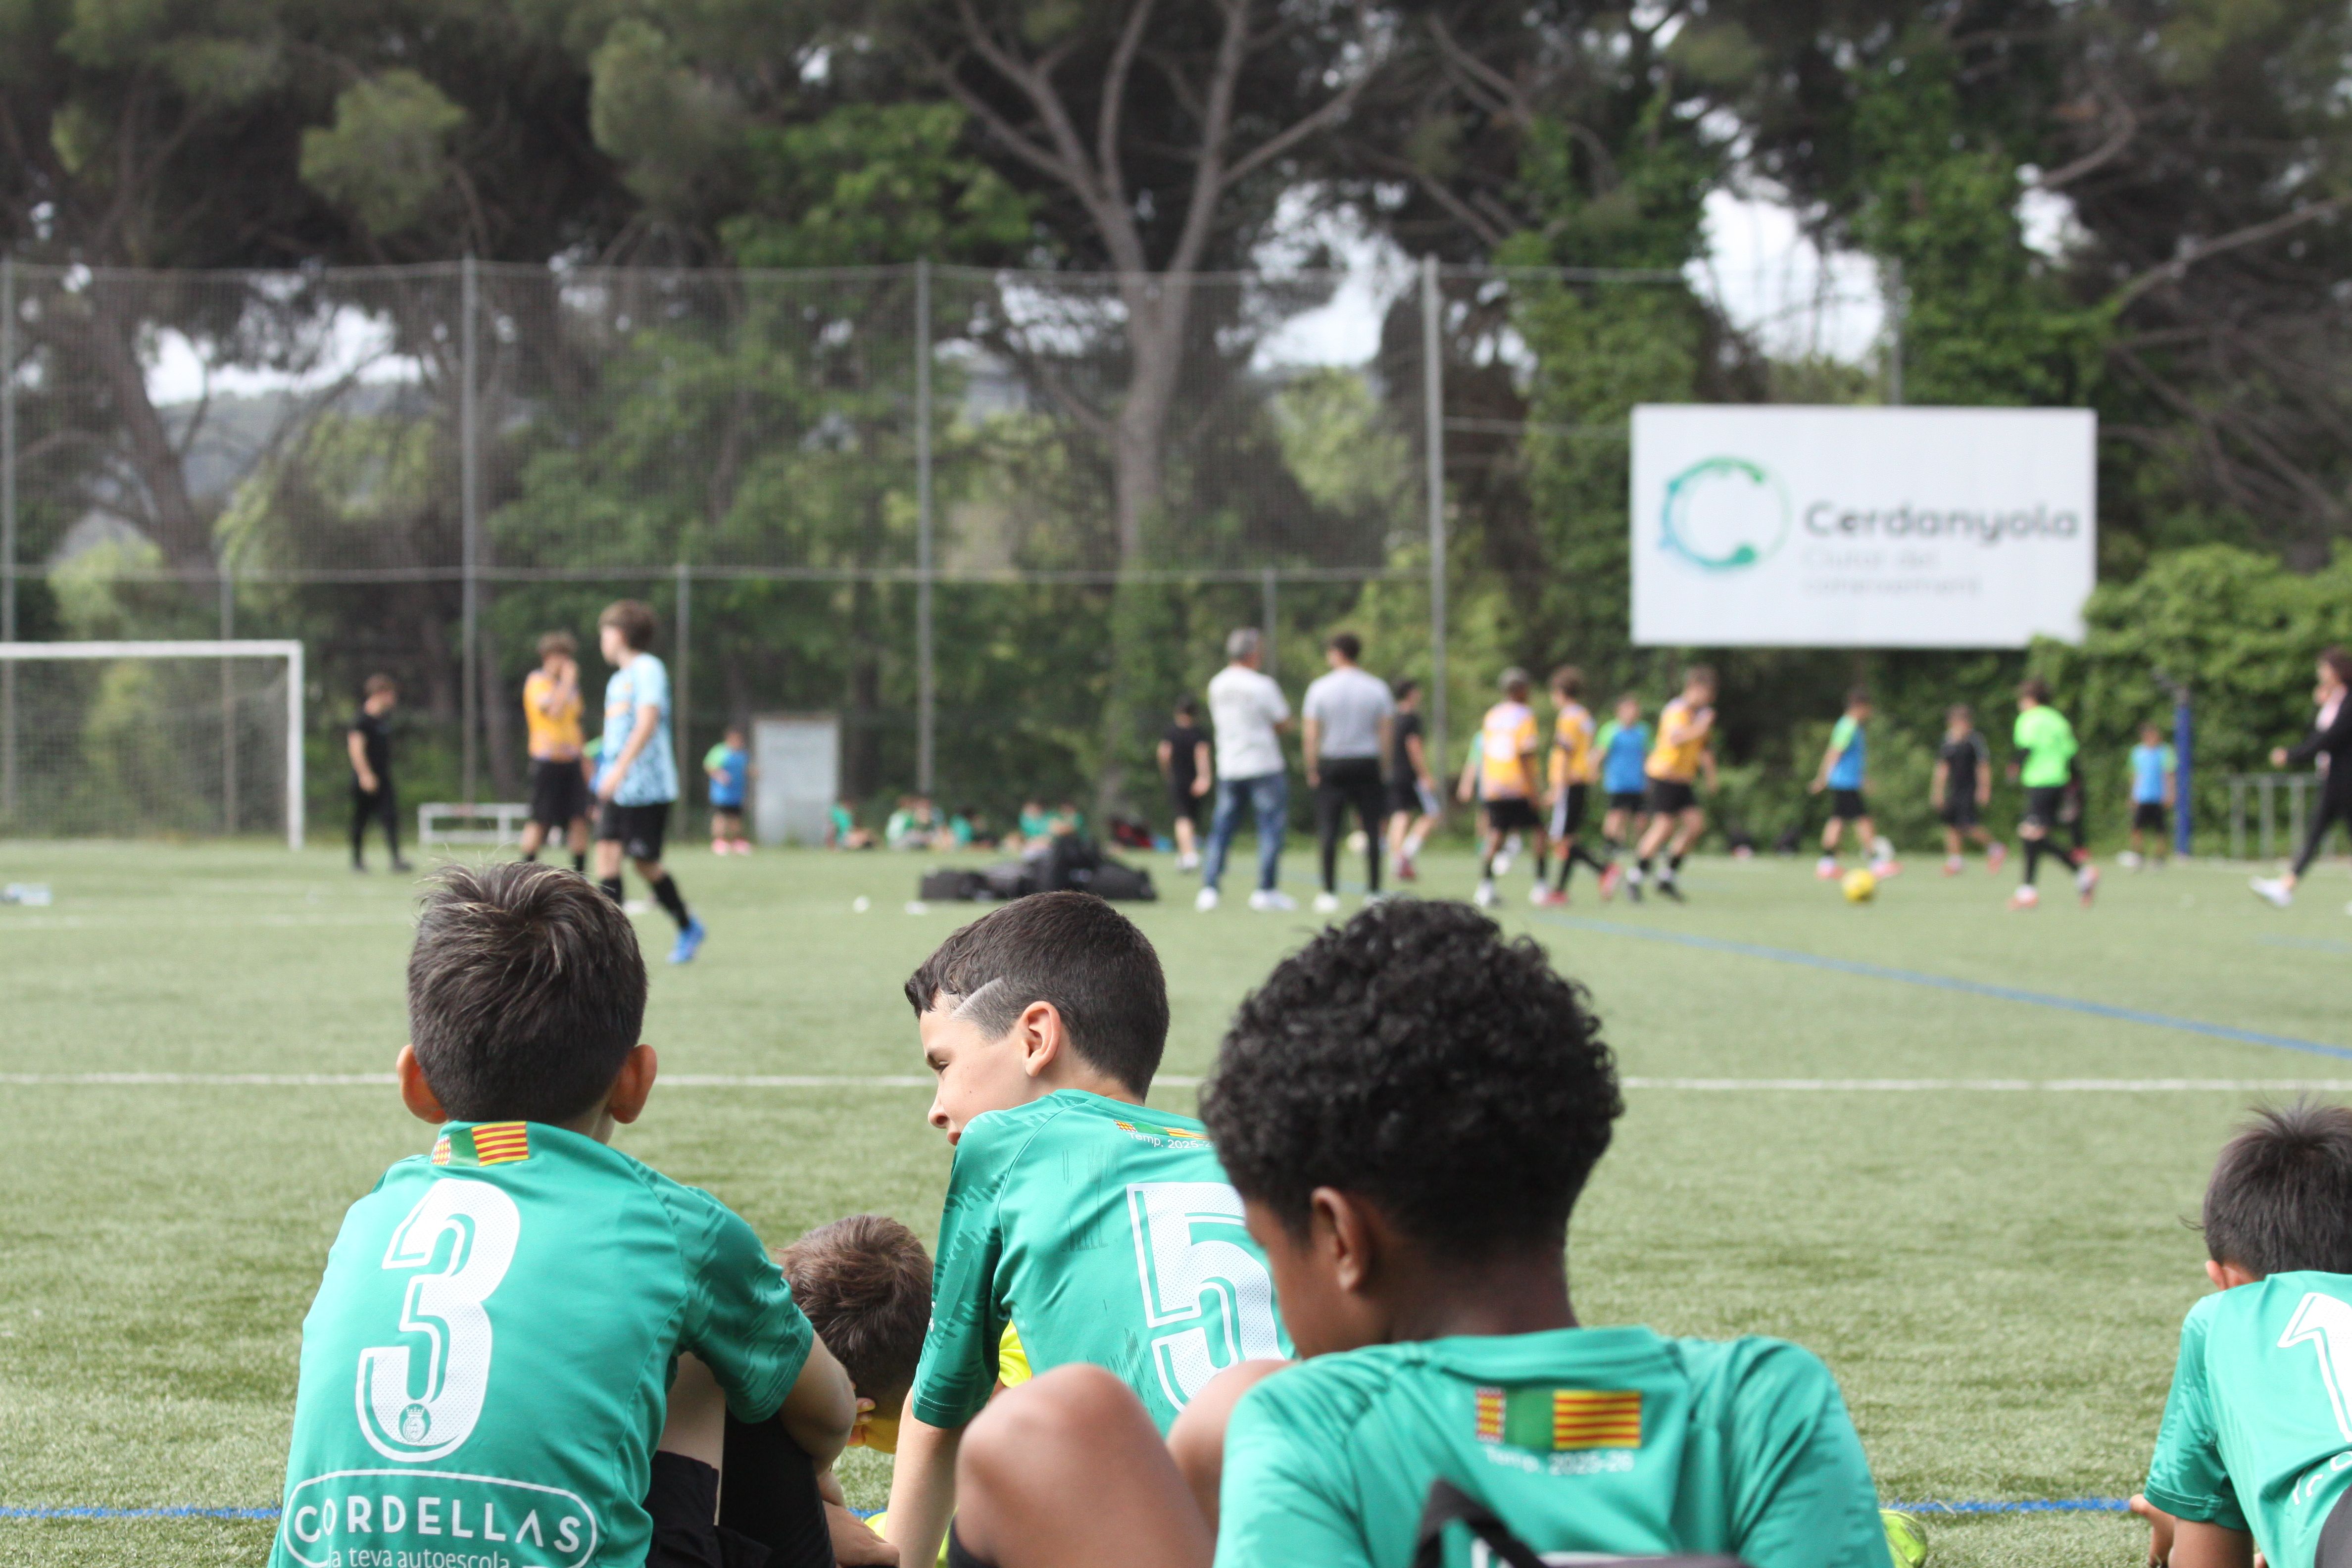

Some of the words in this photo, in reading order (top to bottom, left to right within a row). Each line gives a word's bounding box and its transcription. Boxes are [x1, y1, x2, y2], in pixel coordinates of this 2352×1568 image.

[1804, 500, 2080, 546] Cerdanyola
[1127, 1132, 1163, 1147] Temp.
[1168, 1139, 1213, 1149] 2025-2
[355, 1178, 520, 1463] 3
[1127, 1182, 1286, 1413] 5
[294, 1495, 581, 1553] CORDELLAS
[348, 1547, 392, 1568] teva
[397, 1549, 510, 1568] autoescola
